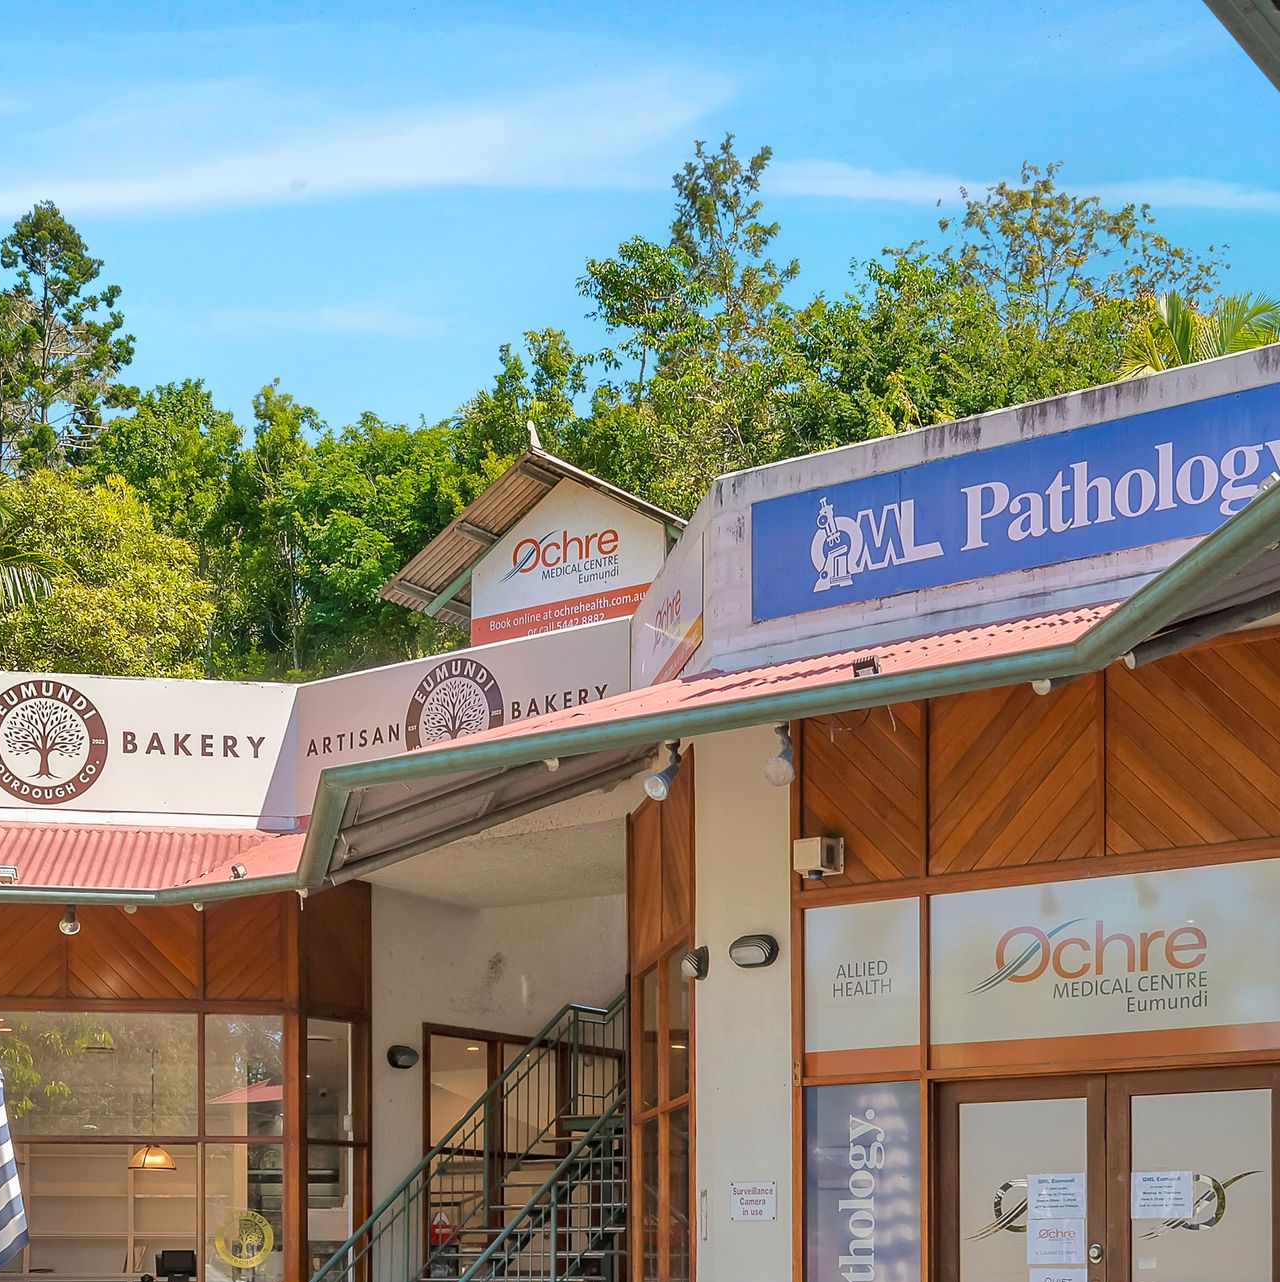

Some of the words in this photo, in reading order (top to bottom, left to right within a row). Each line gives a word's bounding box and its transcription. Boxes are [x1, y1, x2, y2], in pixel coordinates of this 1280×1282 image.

[512, 529, 619, 574] Ochre
[541, 562, 582, 581] MEDICAL
[584, 555, 619, 571] CENTRE
[578, 566, 620, 584] Eumundi
[489, 619, 511, 631] Book
[513, 613, 541, 626] online
[543, 610, 553, 620] at
[554, 592, 647, 617] ochrehealth.com.au
[540, 624, 555, 634] call
[581, 613, 605, 625] 8882
[414, 660, 495, 704] EUMUNDI
[306, 722, 401, 757] ARTISAN
[511, 684, 609, 721] BAKERY
[122, 730, 267, 759] BAKERY
[79, 758, 100, 784] CO.
[995, 919, 1208, 984] Ochre
[835, 959, 889, 980] ALLIED
[831, 976, 893, 998] HEALTH
[1052, 977, 1133, 1000] MEDICAL
[1137, 971, 1208, 992] CENTRE
[1127, 990, 1209, 1014] Eumundi
[732, 1186, 774, 1196] Surveillance
[739, 1197, 766, 1206] Camera
[742, 1207, 749, 1216] in
[750, 1208, 763, 1216] use
[1038, 1228, 1076, 1239] Ochre
